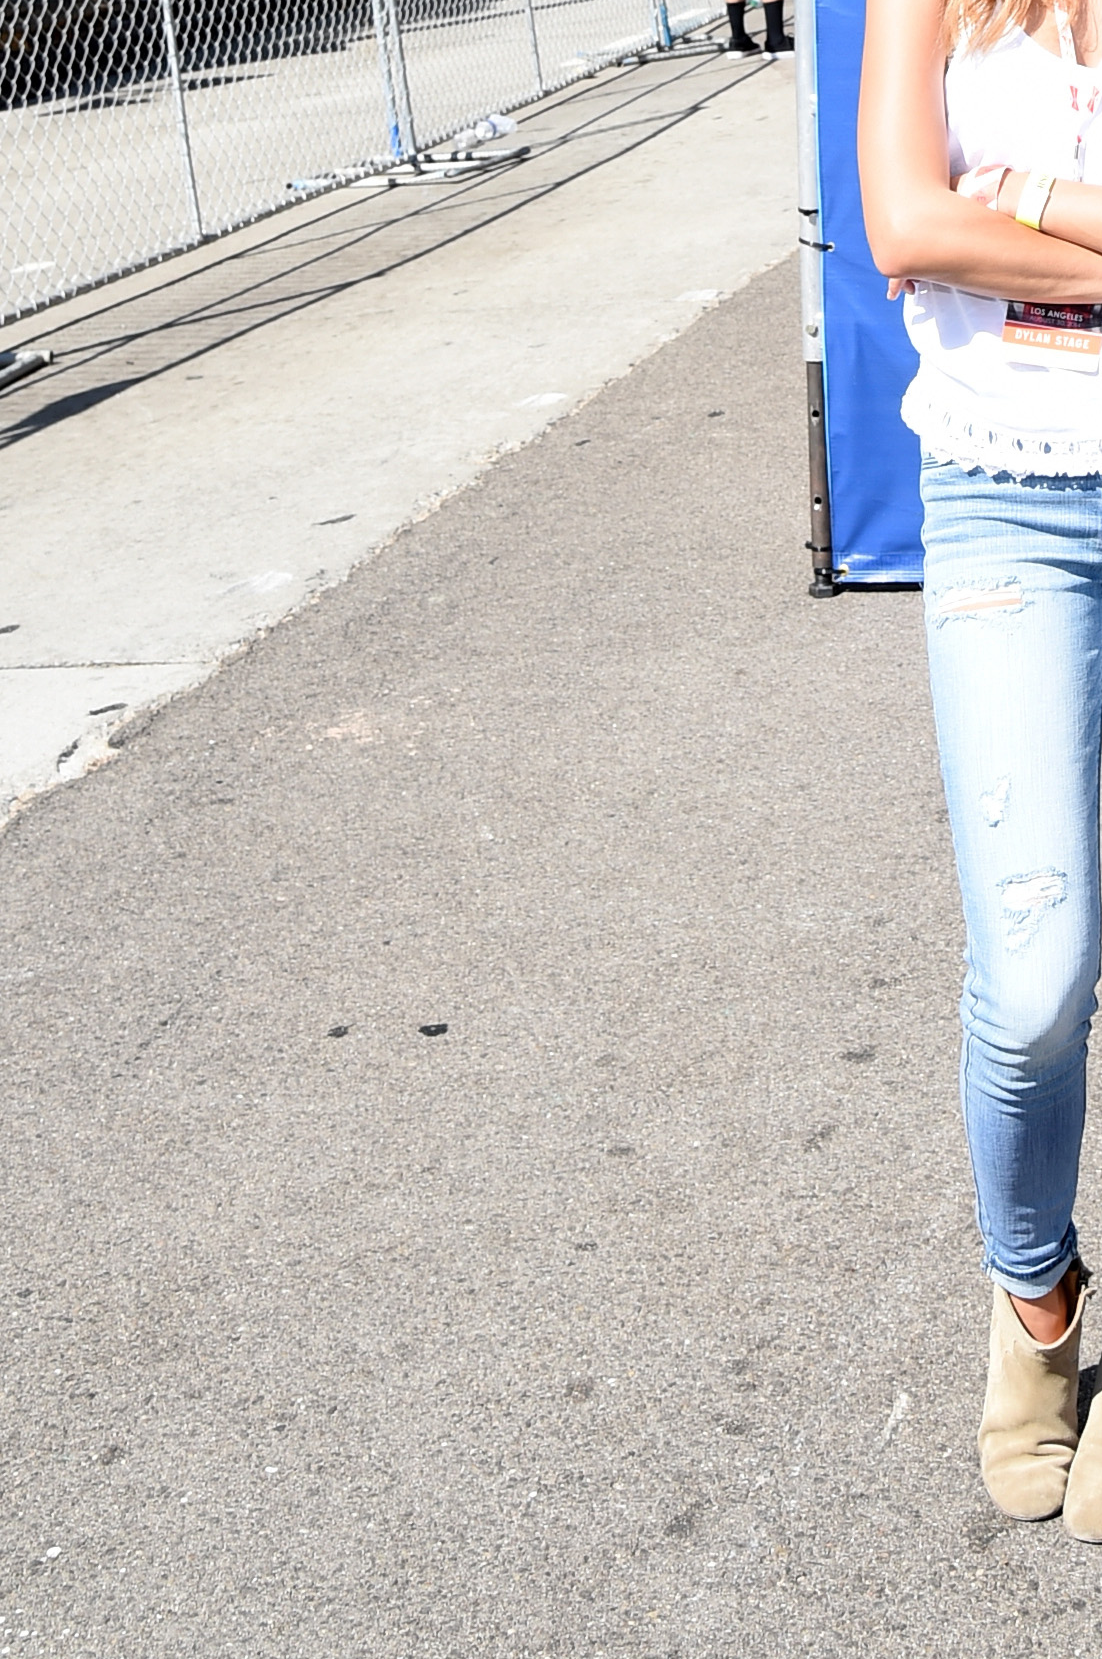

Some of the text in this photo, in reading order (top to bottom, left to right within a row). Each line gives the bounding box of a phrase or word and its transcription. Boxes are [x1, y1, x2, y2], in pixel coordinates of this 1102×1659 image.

[1030, 306, 1084, 322] LOS ANGELES
[1014, 328, 1090, 350] DYLAN STAGE
